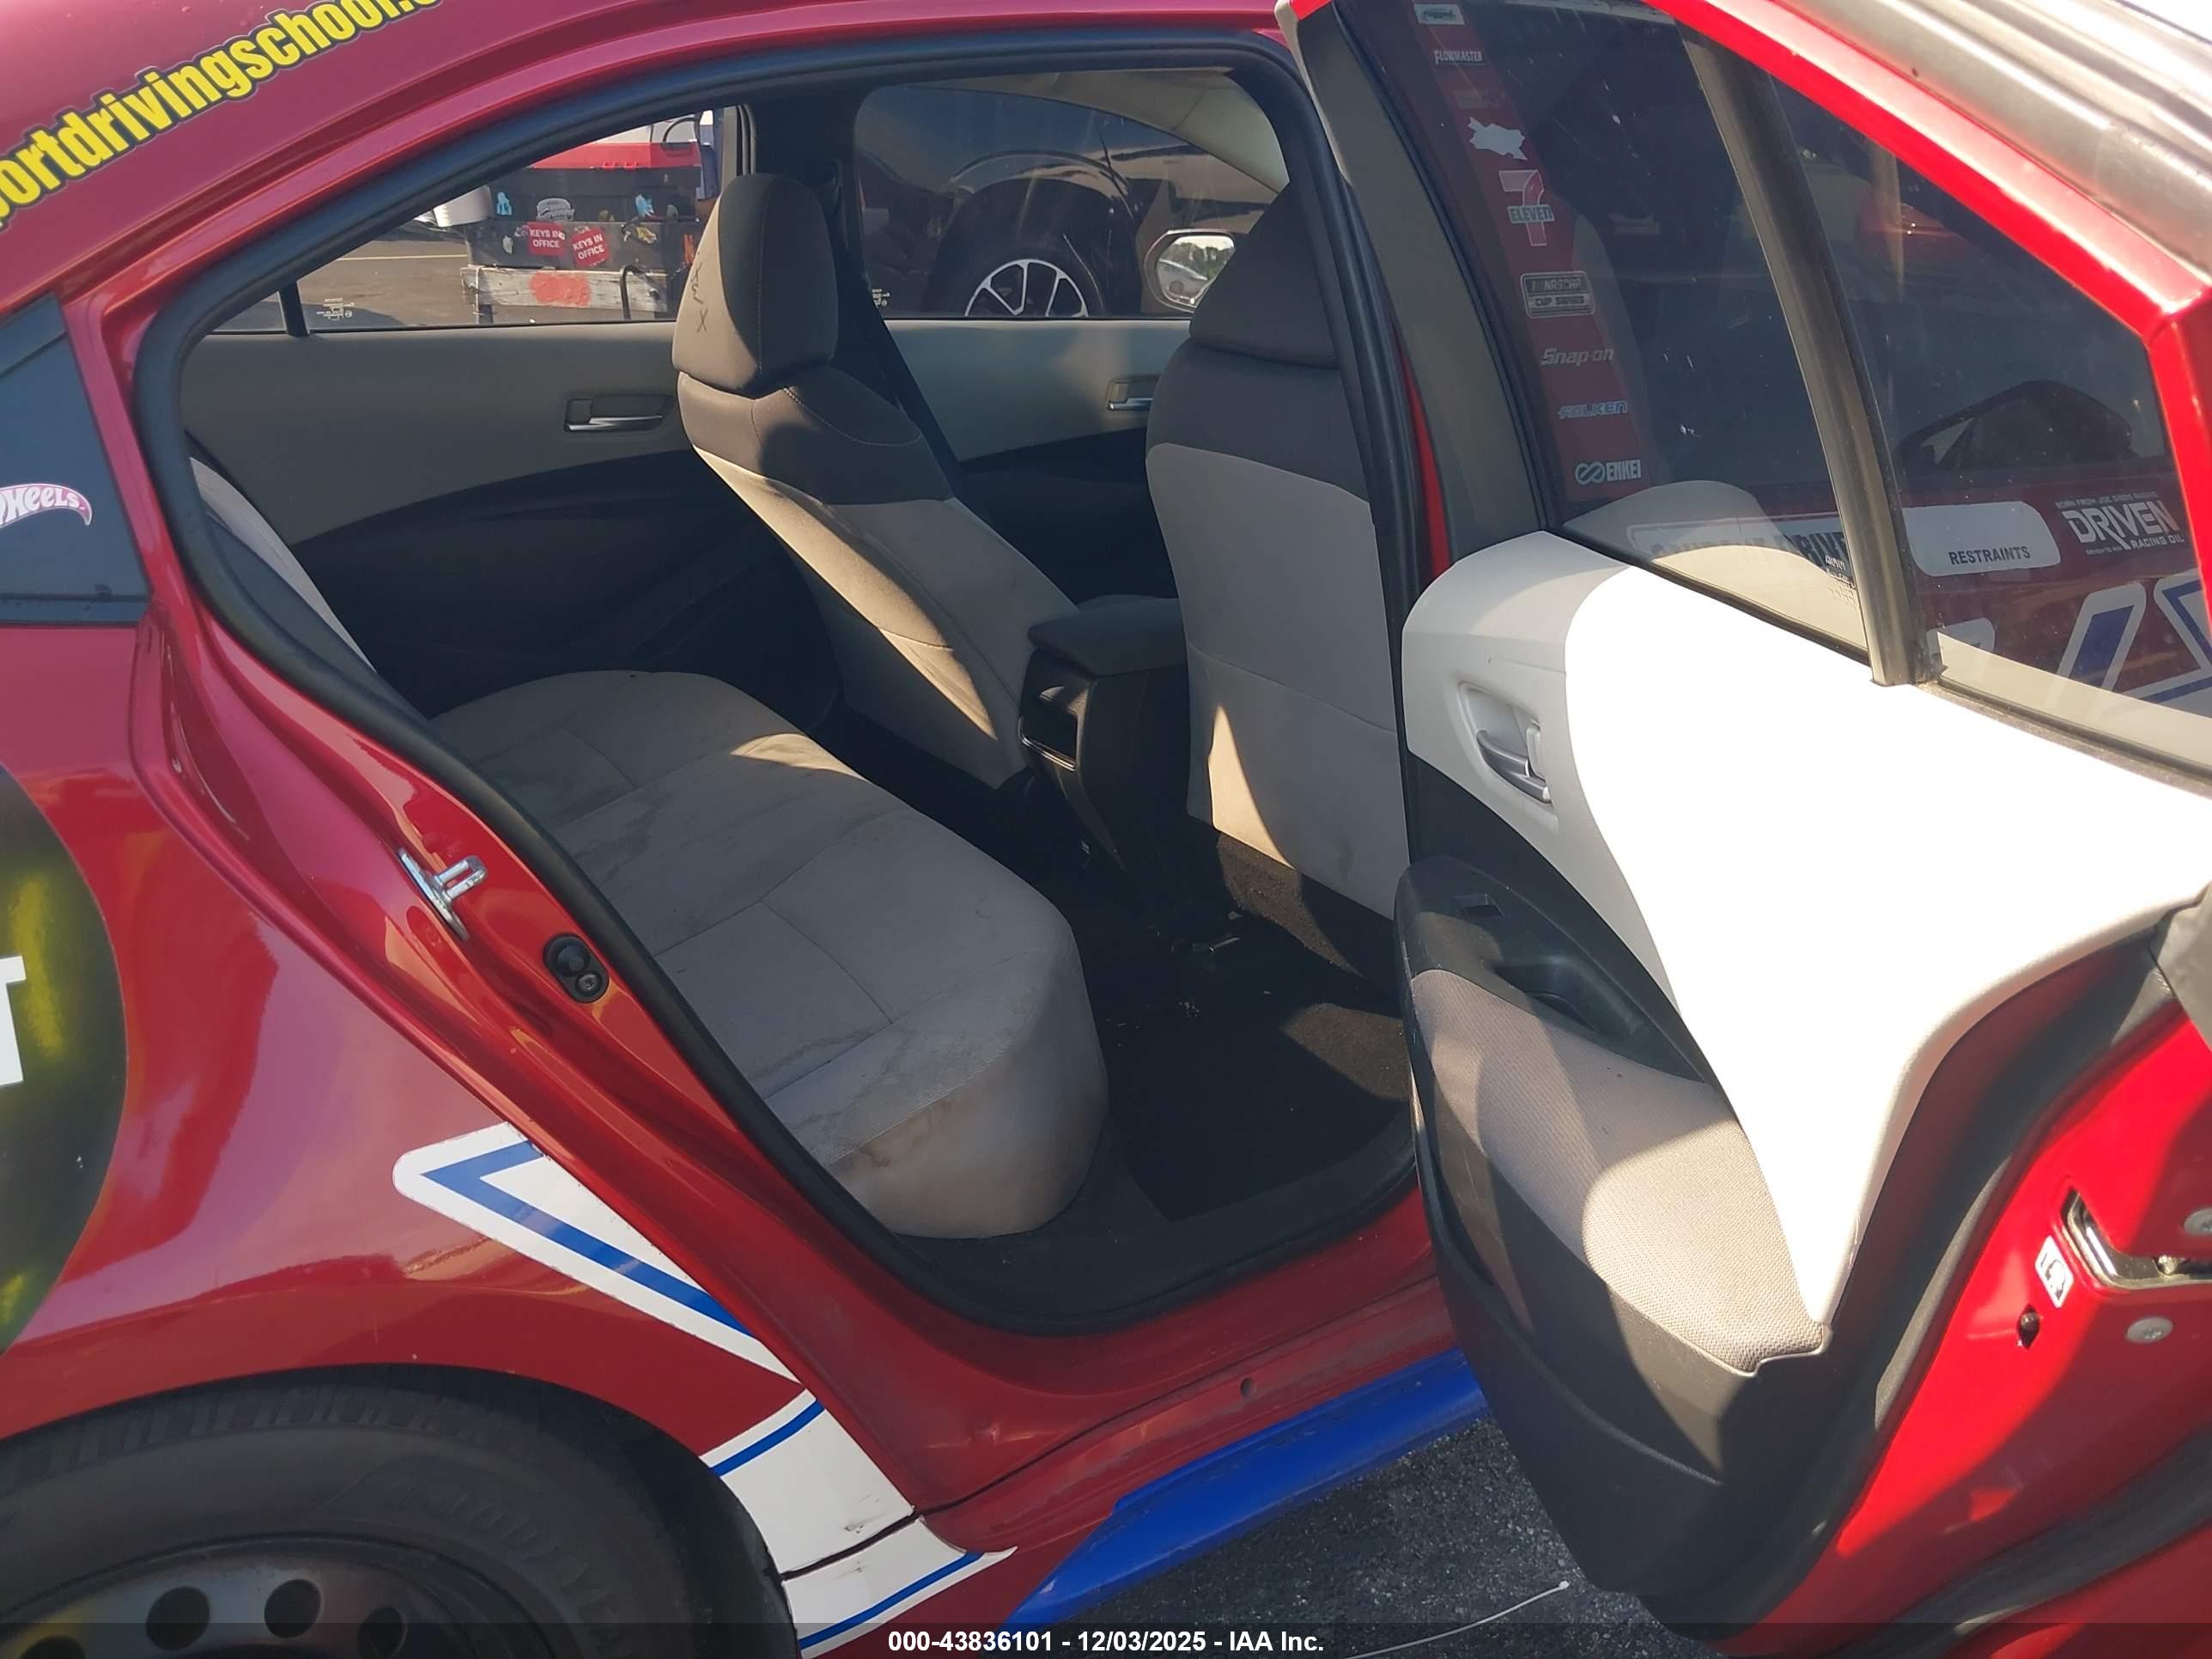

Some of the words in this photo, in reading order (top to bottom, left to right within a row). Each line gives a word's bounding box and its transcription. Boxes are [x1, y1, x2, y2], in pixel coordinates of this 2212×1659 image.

[1434, 50, 1484, 66] FLOWMASTER
[529, 228, 551, 238] KEYS
[532, 240, 561, 248] OFFICE
[572, 237, 594, 252] KEYS
[592, 233, 604, 244] IN
[577, 245, 605, 260] OFFICE
[1540, 348, 1615, 367] Snap-on
[1606, 459, 1642, 482] ENKEI
[2061, 501, 2180, 550] DRIVEN
[2130, 535, 2167, 550] RACING
[2169, 534, 2185, 544] OIL
[1948, 546, 2031, 565] RESTRAINTS
